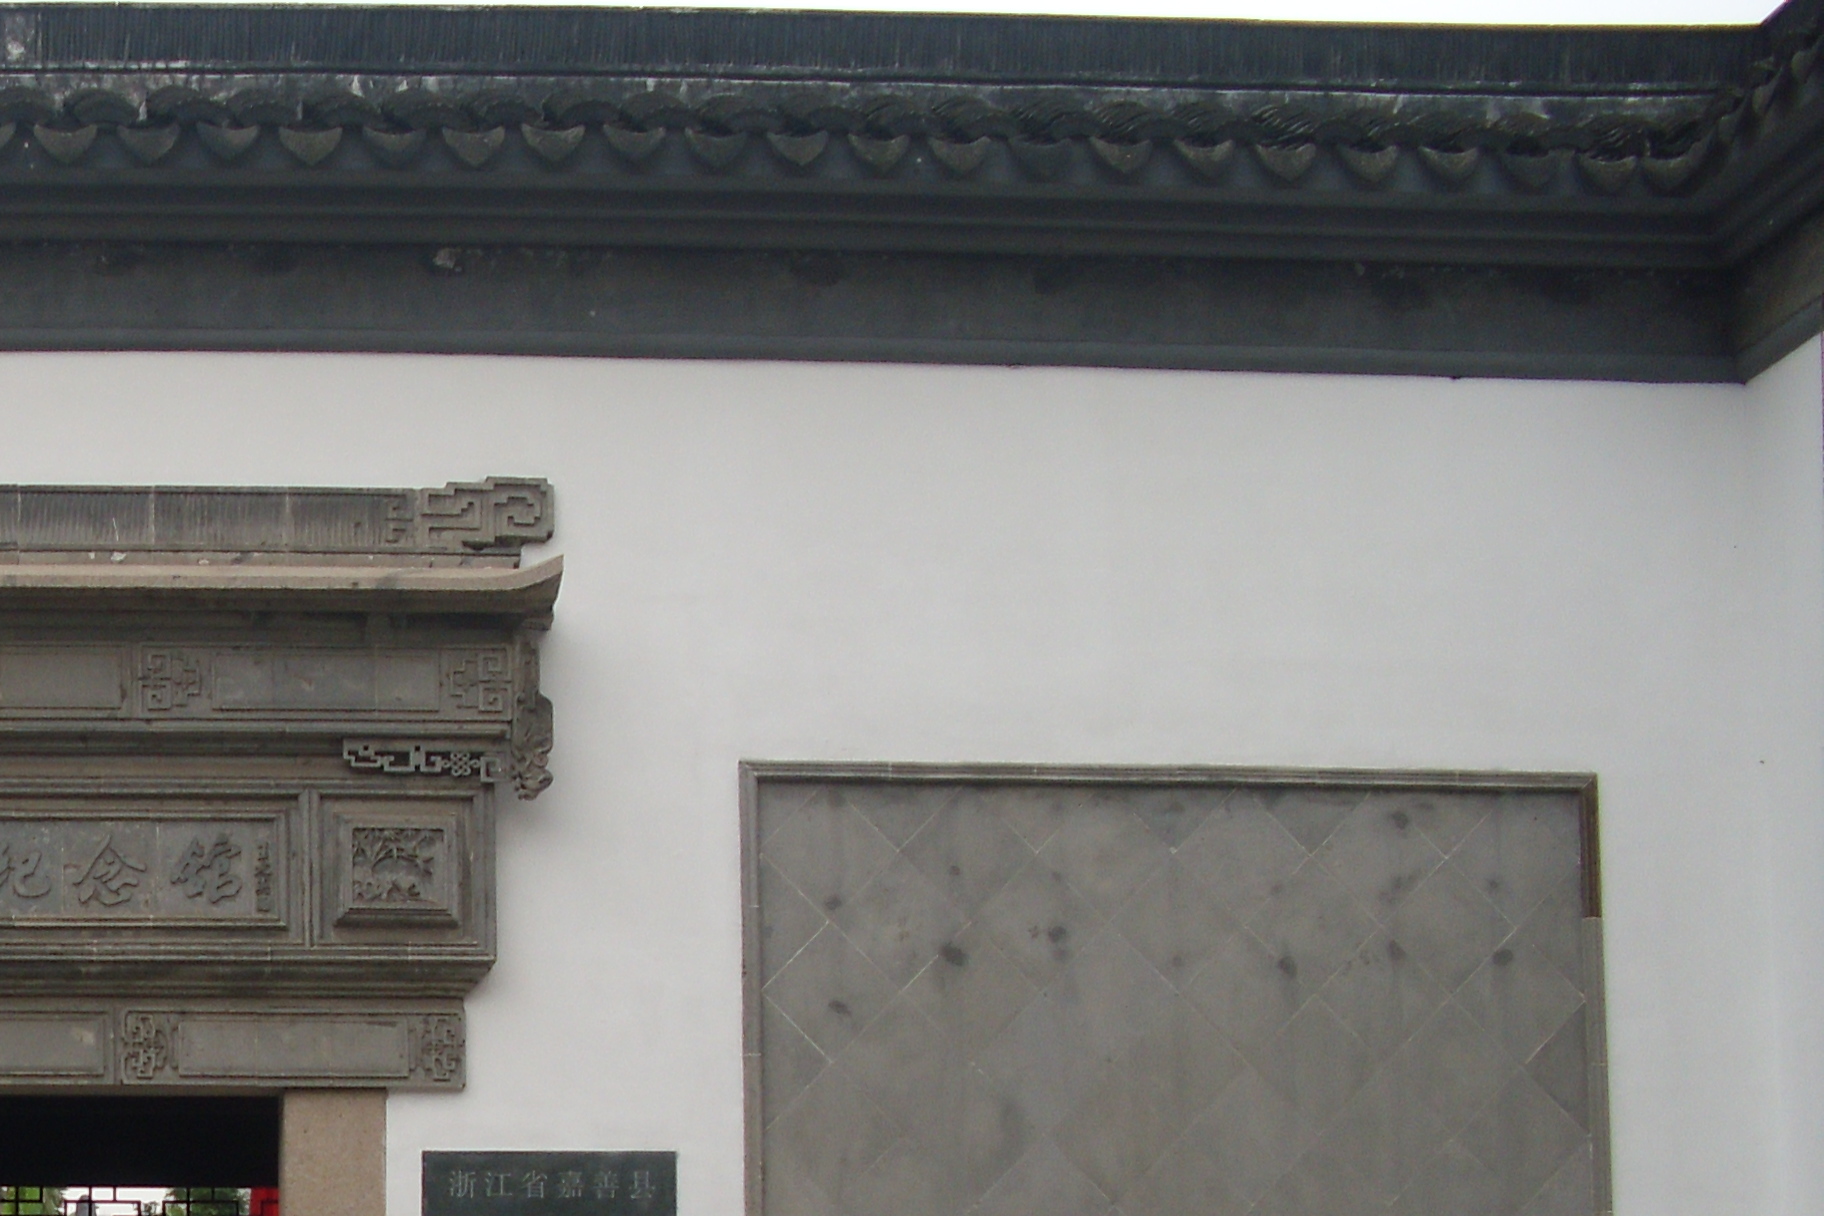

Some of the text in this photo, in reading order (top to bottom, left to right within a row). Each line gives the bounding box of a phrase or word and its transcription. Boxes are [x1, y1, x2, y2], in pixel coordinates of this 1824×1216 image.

[449, 1170, 656, 1199] 浙江省嘉善县
